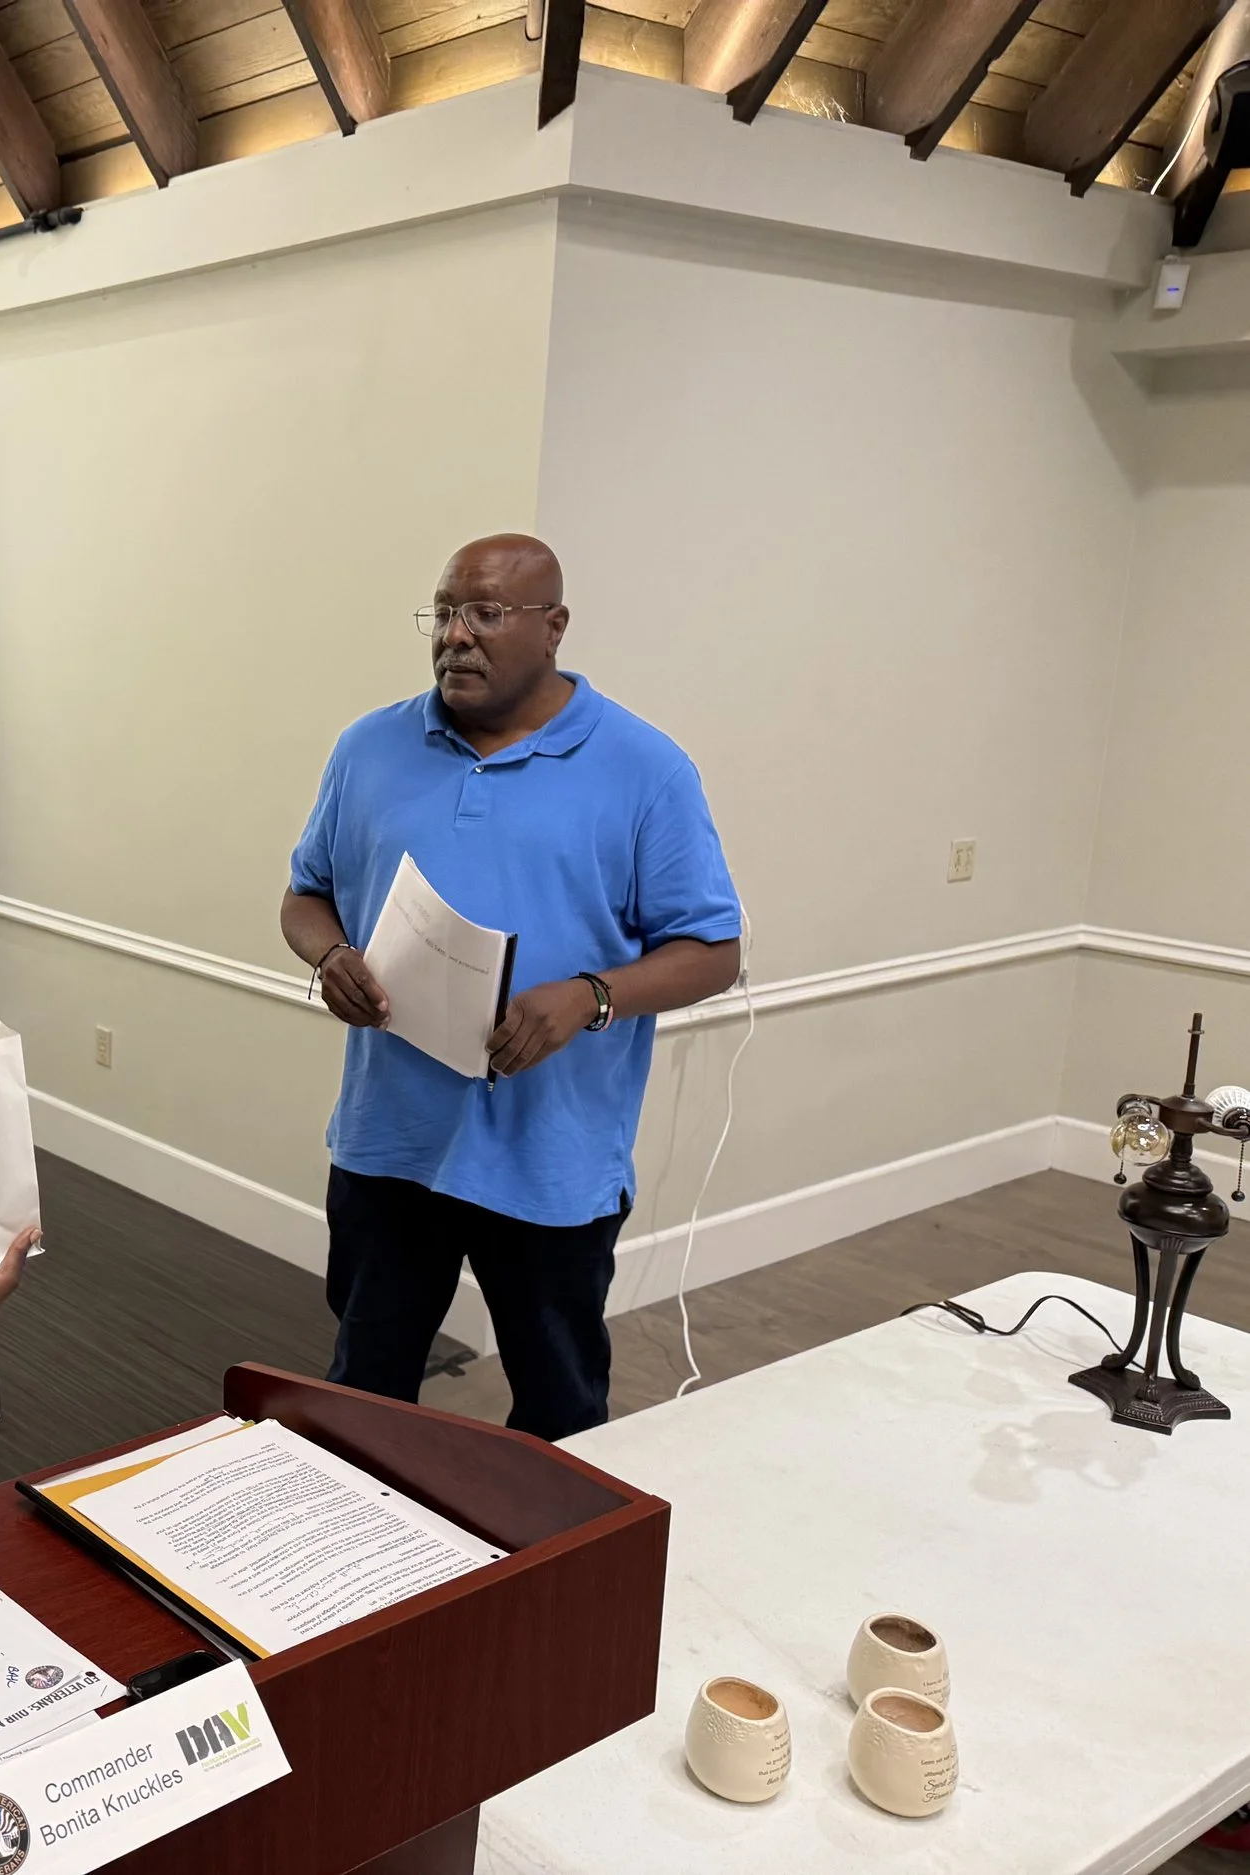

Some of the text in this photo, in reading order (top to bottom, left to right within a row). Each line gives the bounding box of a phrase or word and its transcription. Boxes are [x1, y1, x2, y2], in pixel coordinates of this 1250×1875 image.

[6, 1708, 30, 1725] OUR
[30, 1678, 86, 1712] VETERANS:
[175, 1702, 251, 1766] DAV
[45, 1743, 153, 1803] Commander
[40, 1768, 183, 1846] Bonita Knuckles
